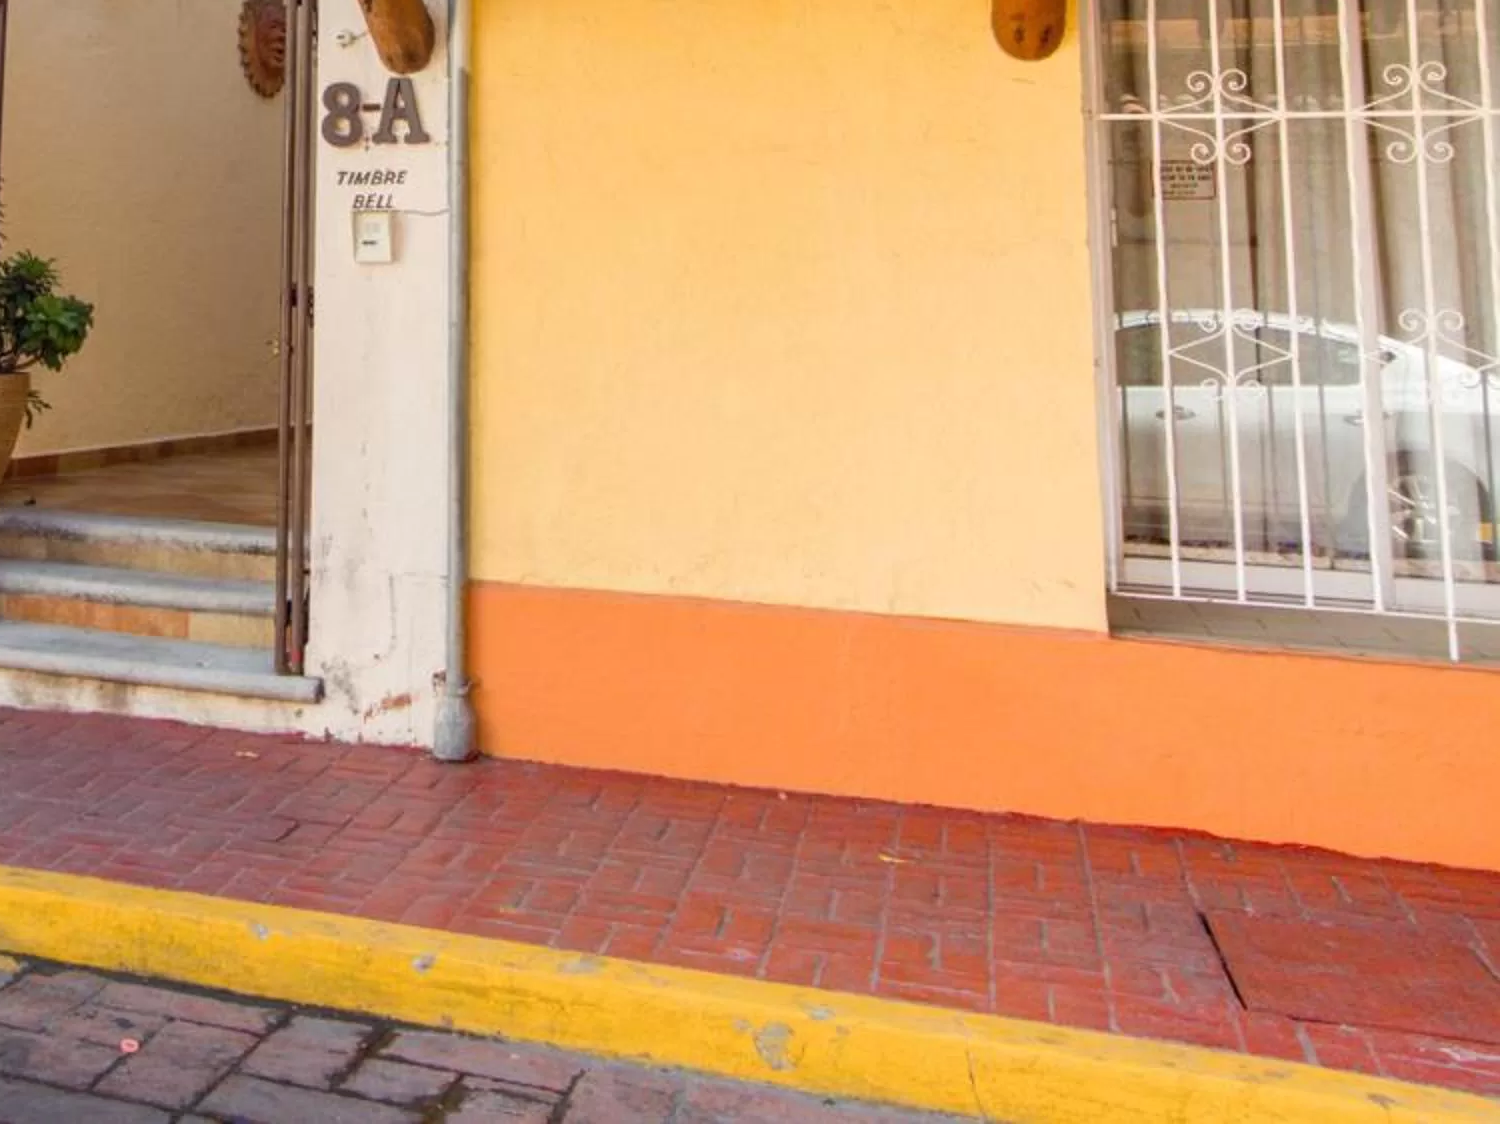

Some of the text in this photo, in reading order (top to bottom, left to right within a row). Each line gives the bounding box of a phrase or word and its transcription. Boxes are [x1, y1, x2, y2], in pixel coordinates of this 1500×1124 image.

[321, 76, 431, 149] 8-A
[336, 170, 409, 186] TIMBRE
[352, 193, 395, 210] BELL
